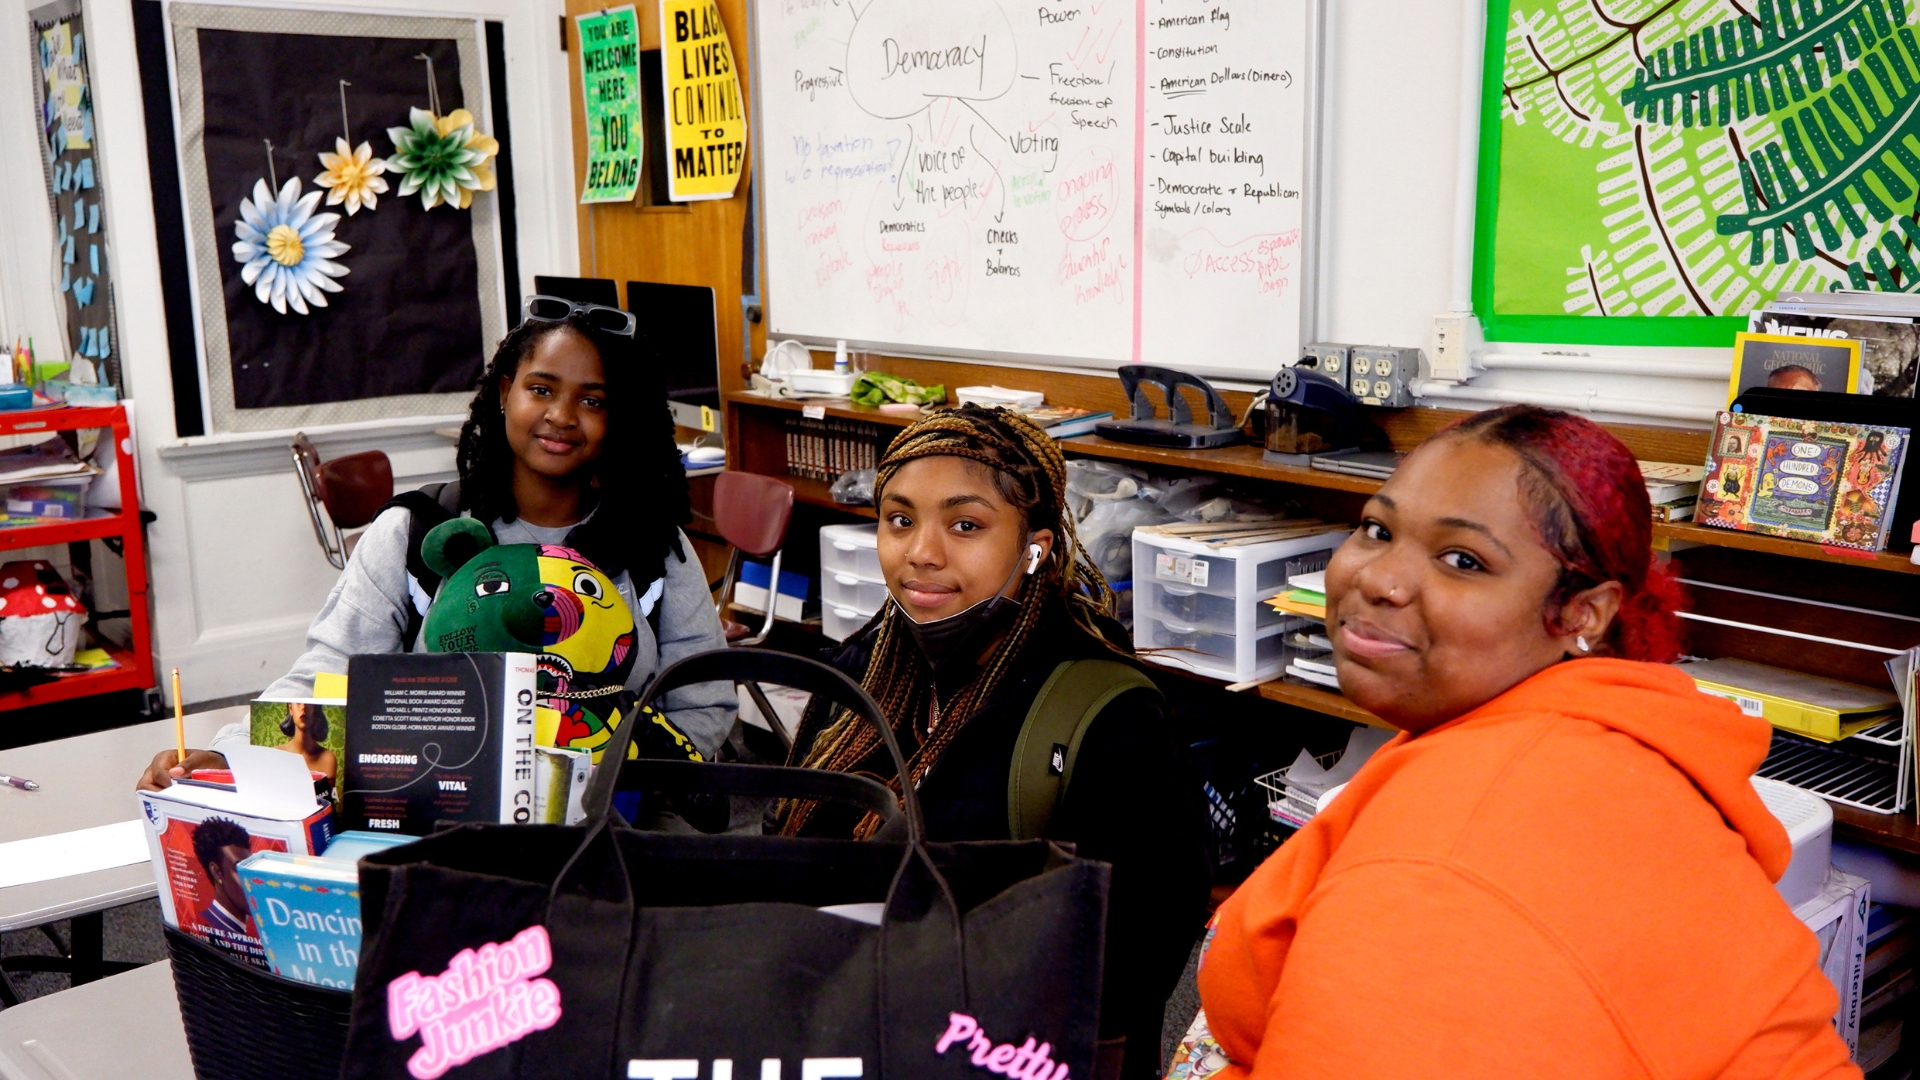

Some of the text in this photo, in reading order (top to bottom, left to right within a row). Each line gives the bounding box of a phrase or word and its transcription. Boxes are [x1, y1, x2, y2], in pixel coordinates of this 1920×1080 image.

[1038, 6, 1081, 26] Power
[1158, 14, 1205, 29] American
[588, 20, 629, 41] YOU ARE
[584, 43, 637, 73] WELCOME
[682, 41, 729, 79] LIVES
[1157, 44, 1218, 60] Constitution
[599, 77, 625, 103] HERE
[1160, 76, 1206, 91] American
[673, 79, 741, 126] CONTINUE
[601, 113, 628, 153] YOU
[700, 128, 724, 139] TO
[1164, 115, 1212, 135] Justice
[675, 141, 743, 179] MATTER
[951, 146, 965, 170] of
[1009, 131, 1058, 173] Voting
[1163, 146, 1264, 177] Capital building
[589, 158, 638, 189] BELONG
[916, 177, 978, 210] the people
[1158, 177, 1223, 195] Democratic
[1244, 183, 1299, 204] Republican
[1773, 350, 1820, 362] NATIONAL
[1793, 445, 1818, 456] ONE!
[1782, 461, 1818, 473] HUNDRED!
[1781, 479, 1817, 491] DEMONS!
[439, 625, 478, 643] FOLLOW
[440, 635, 477, 653] YOUR
[517, 689, 533, 725] ON
[359, 753, 418, 765] ENGROSSING
[515, 734, 532, 781] THE
[438, 781, 467, 791] VITAL
[368, 818, 400, 829] FRESH
[198, 924, 226, 937] FIGURE
[214, 938, 231, 949] AND
[231, 942, 249, 953] THE
[294, 935, 322, 963] in
[388, 925, 552, 1040] Fashion
[1849, 953, 1862, 1029] Filterbuy
[407, 978, 562, 1080] Junkie
